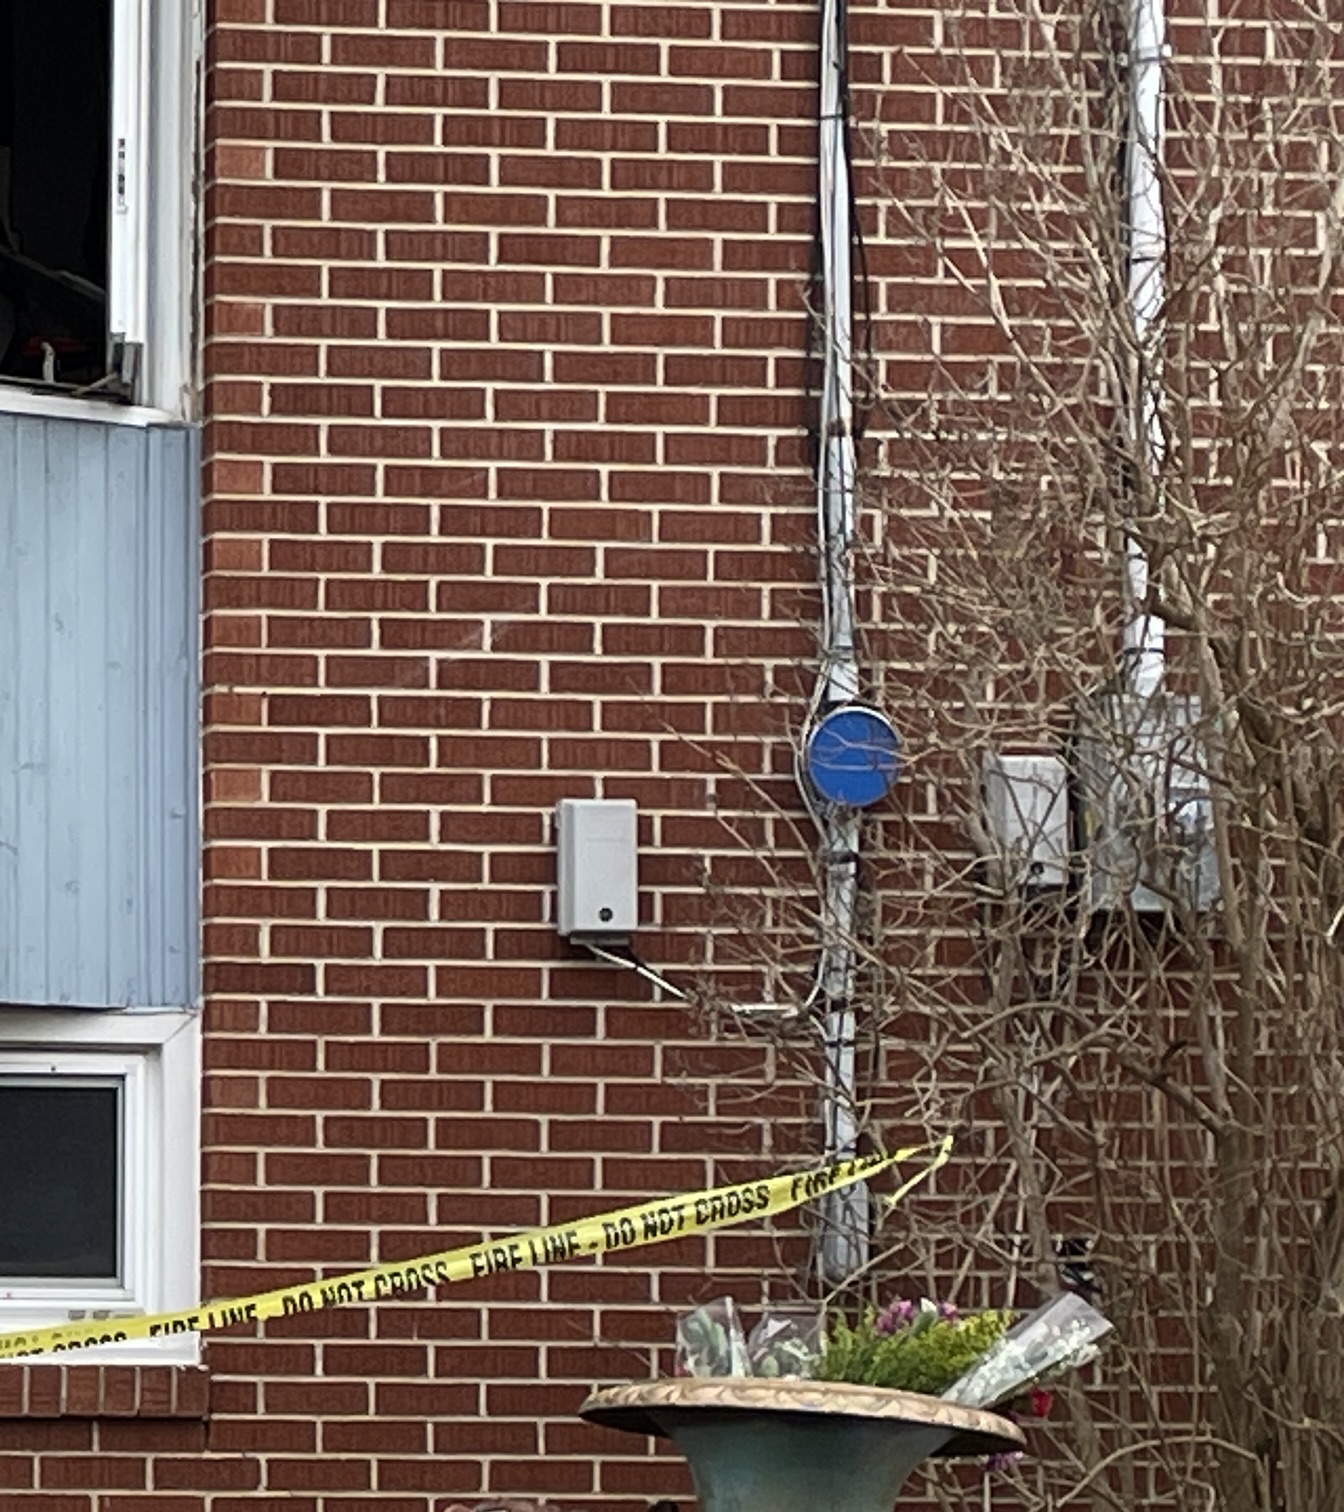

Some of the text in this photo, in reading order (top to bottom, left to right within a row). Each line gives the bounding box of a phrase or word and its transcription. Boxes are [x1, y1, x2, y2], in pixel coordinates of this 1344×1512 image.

[374, 1260, 452, 1297] CROSS
[469, 1243, 523, 1278] FIRE
[528, 1230, 582, 1266] LINE
[601, 1216, 637, 1250] DO
[639, 1204, 687, 1239] NOT
[694, 1183, 771, 1225] CROSS
